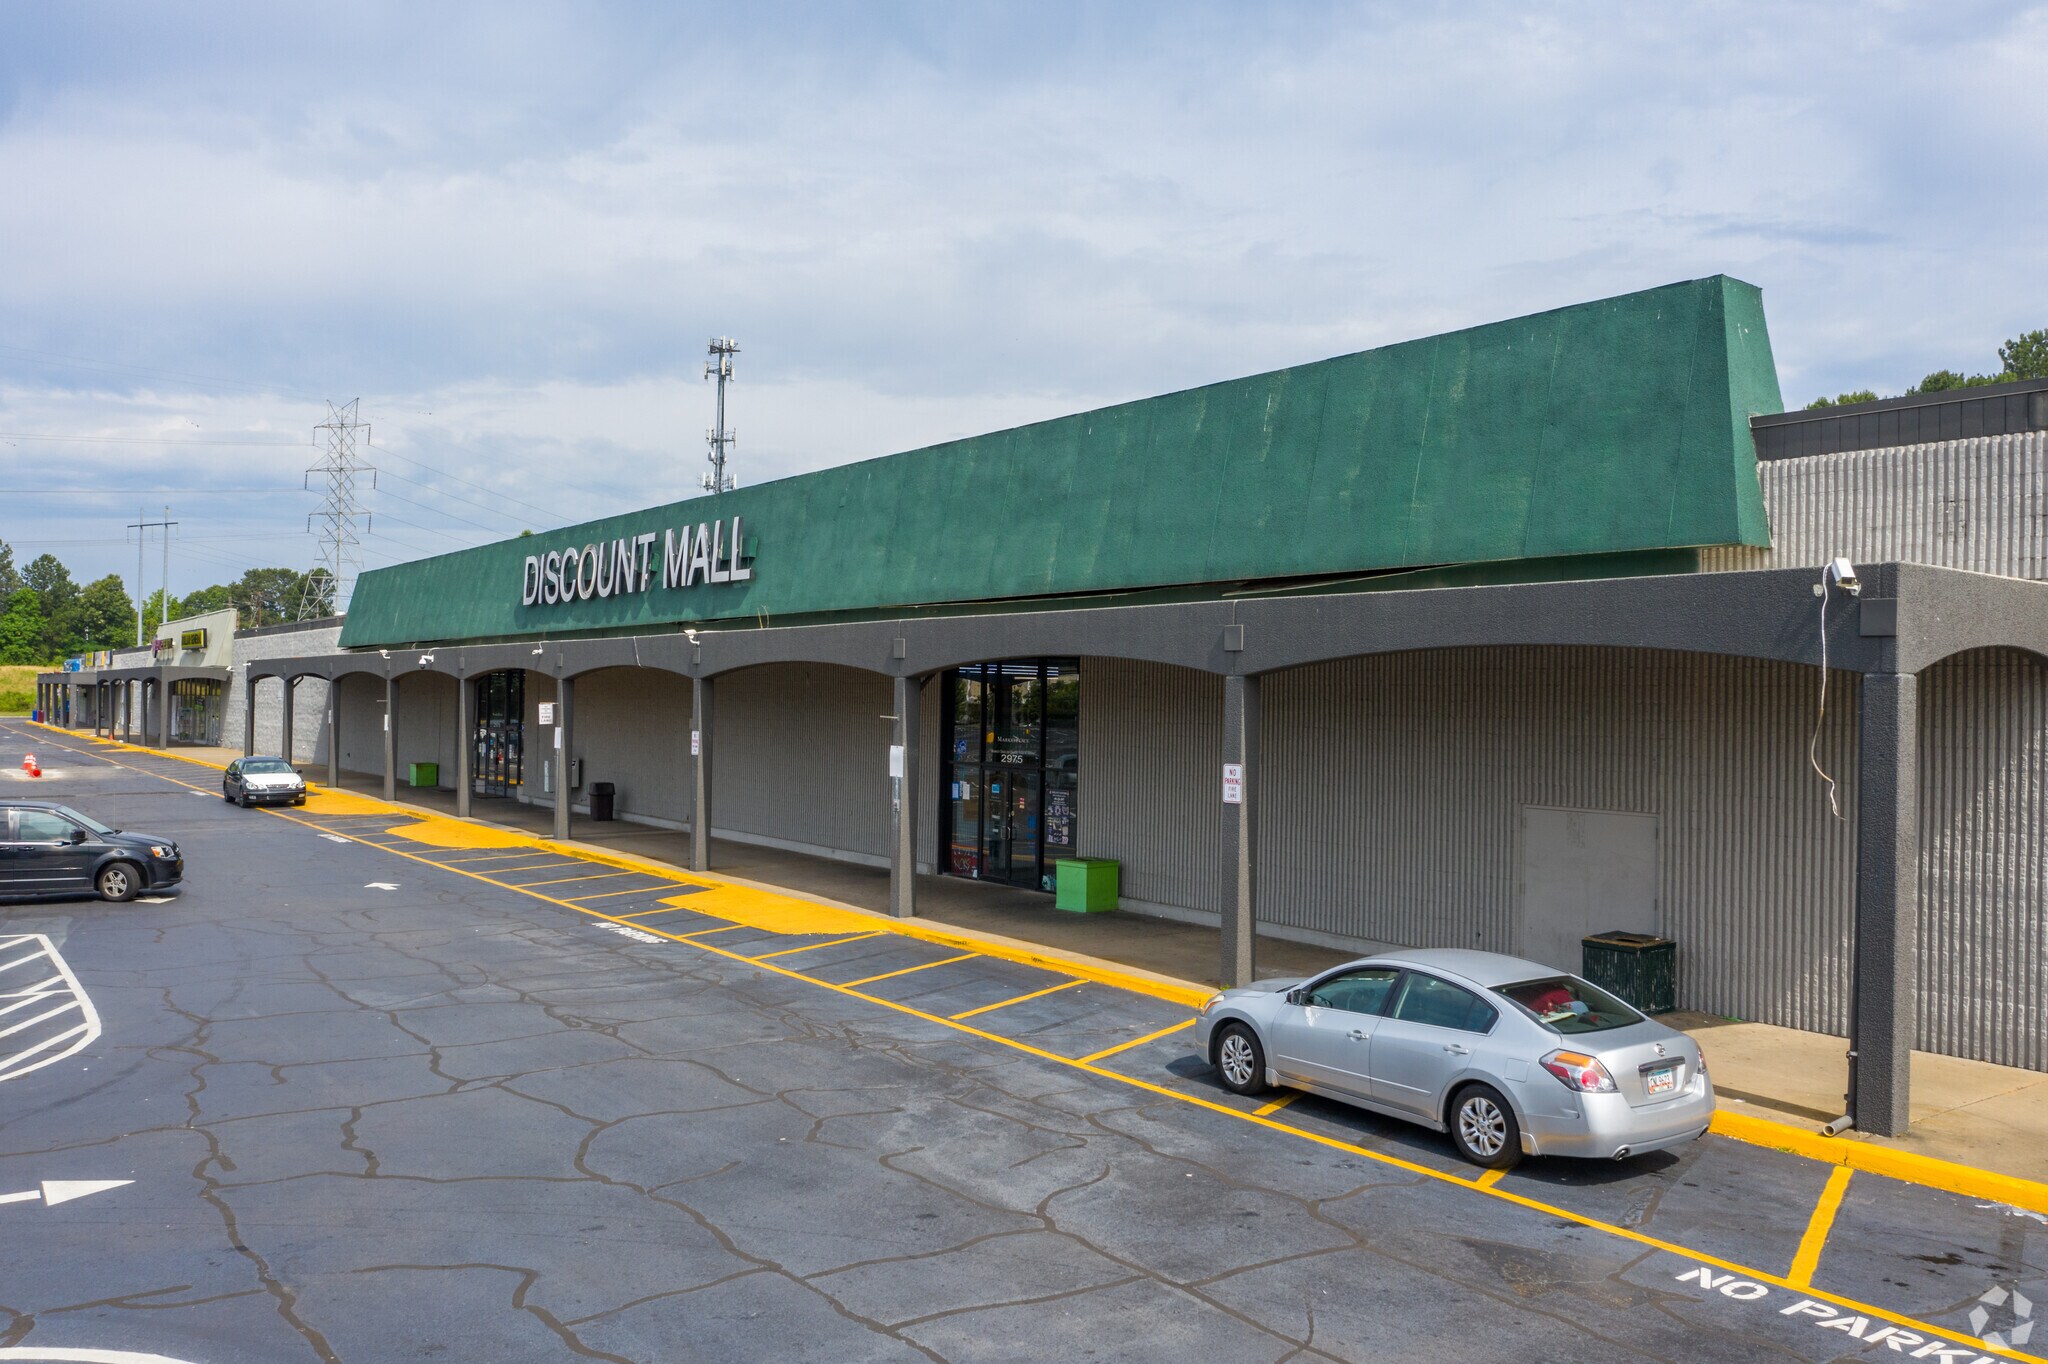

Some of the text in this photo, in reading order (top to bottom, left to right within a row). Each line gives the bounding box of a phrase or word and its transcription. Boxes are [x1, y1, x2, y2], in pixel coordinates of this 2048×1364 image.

[522, 516, 752, 606] DISCOUNT MALL
[1001, 754, 1023, 764] 2975
[1224, 777, 1241, 785] PARKING
[1675, 1266, 2008, 1364] NO PARK
